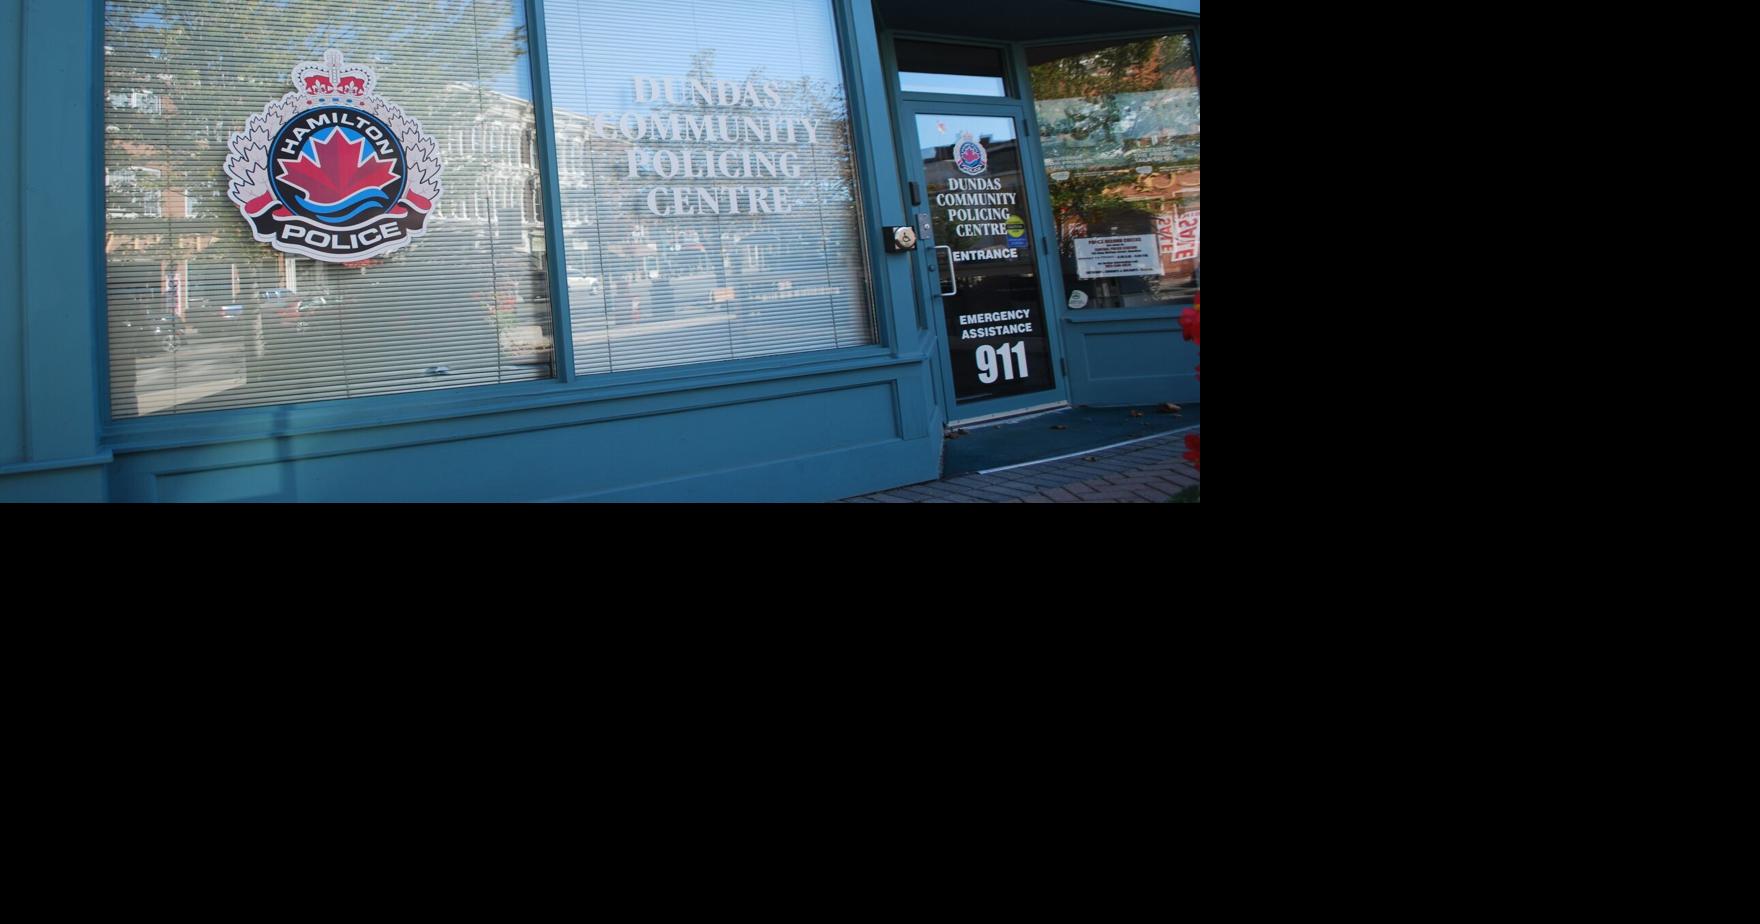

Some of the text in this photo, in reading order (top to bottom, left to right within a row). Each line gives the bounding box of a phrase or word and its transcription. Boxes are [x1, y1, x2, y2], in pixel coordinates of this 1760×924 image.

[633, 75, 782, 109] DUNDAS
[281, 112, 394, 156] HAMILTON
[593, 111, 820, 144] COMMUNITY
[625, 148, 801, 179] POLICING
[948, 177, 1002, 191] DUNDAS
[647, 185, 792, 216] CENTRE
[936, 192, 1017, 207] COMMUNITY
[948, 207, 1010, 222] POLICING
[281, 221, 402, 250] POLICE
[956, 223, 1008, 237] CENTRE
[953, 248, 1018, 262] ENTRANCE
[959, 308, 1030, 325] EMERGENCY
[961, 322, 1033, 340] ASSISTANCE
[975, 340, 1029, 384] 911
